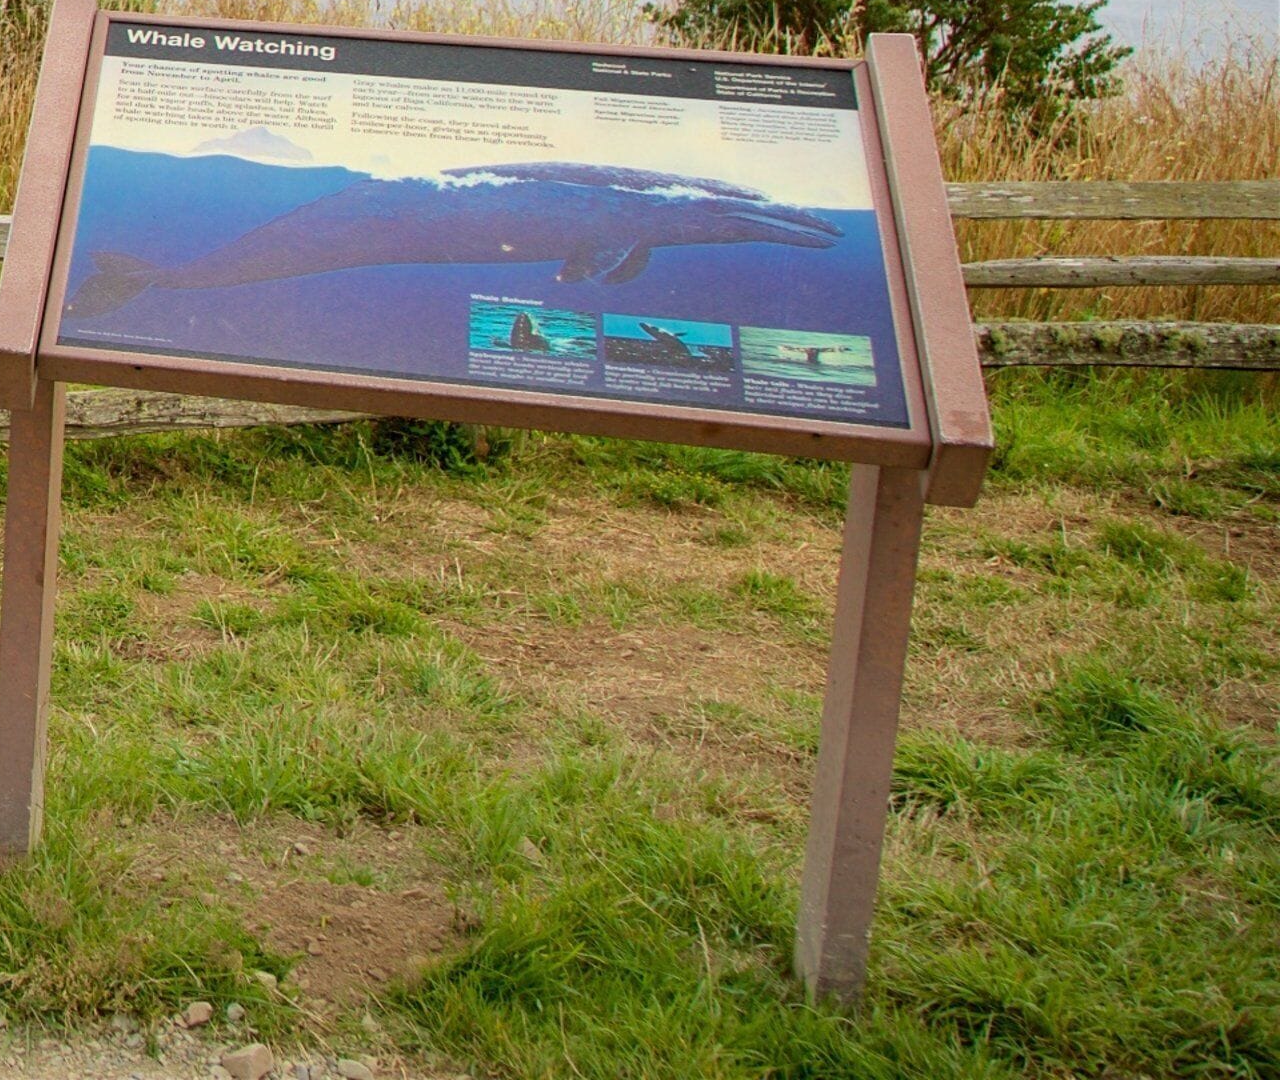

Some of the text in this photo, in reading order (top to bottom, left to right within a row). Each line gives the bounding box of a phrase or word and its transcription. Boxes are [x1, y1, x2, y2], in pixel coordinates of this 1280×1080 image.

[127, 29, 336, 61] Whale Watching
[501, 297, 543, 305] Behavior
